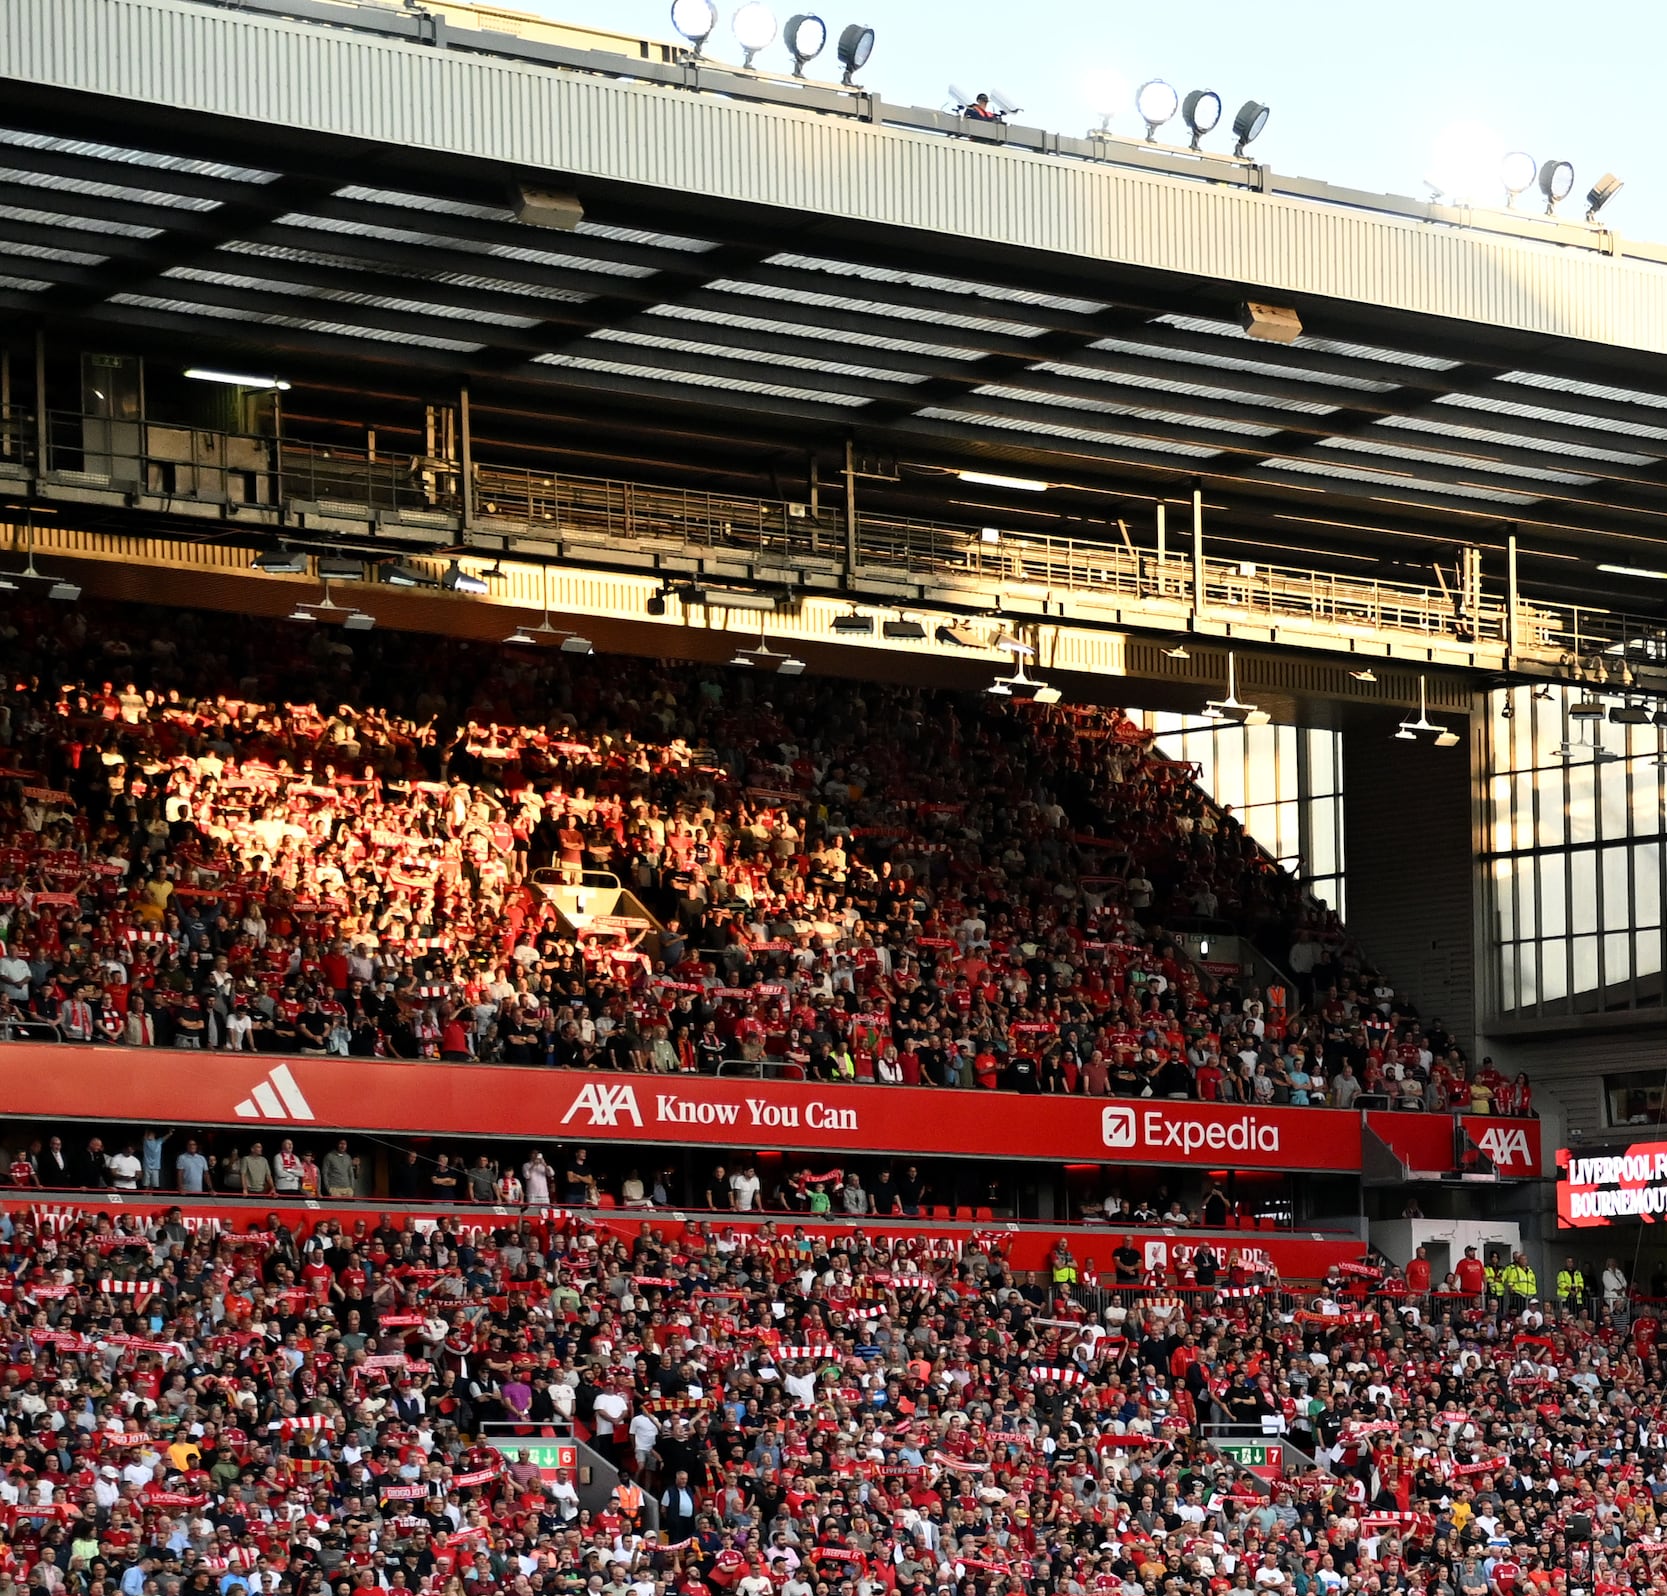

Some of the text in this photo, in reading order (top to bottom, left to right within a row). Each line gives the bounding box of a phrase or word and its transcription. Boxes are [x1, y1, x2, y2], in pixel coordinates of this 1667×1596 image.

[560, 1083, 859, 1130] AXA Know You Can
[1144, 1111, 1279, 1155] Expedia
[1478, 1128, 1533, 1166] AXA
[1566, 1152, 1655, 1188] LIVERPOOL
[562, 1451, 571, 1464] 6
[1270, 1449, 1278, 1464] 7
